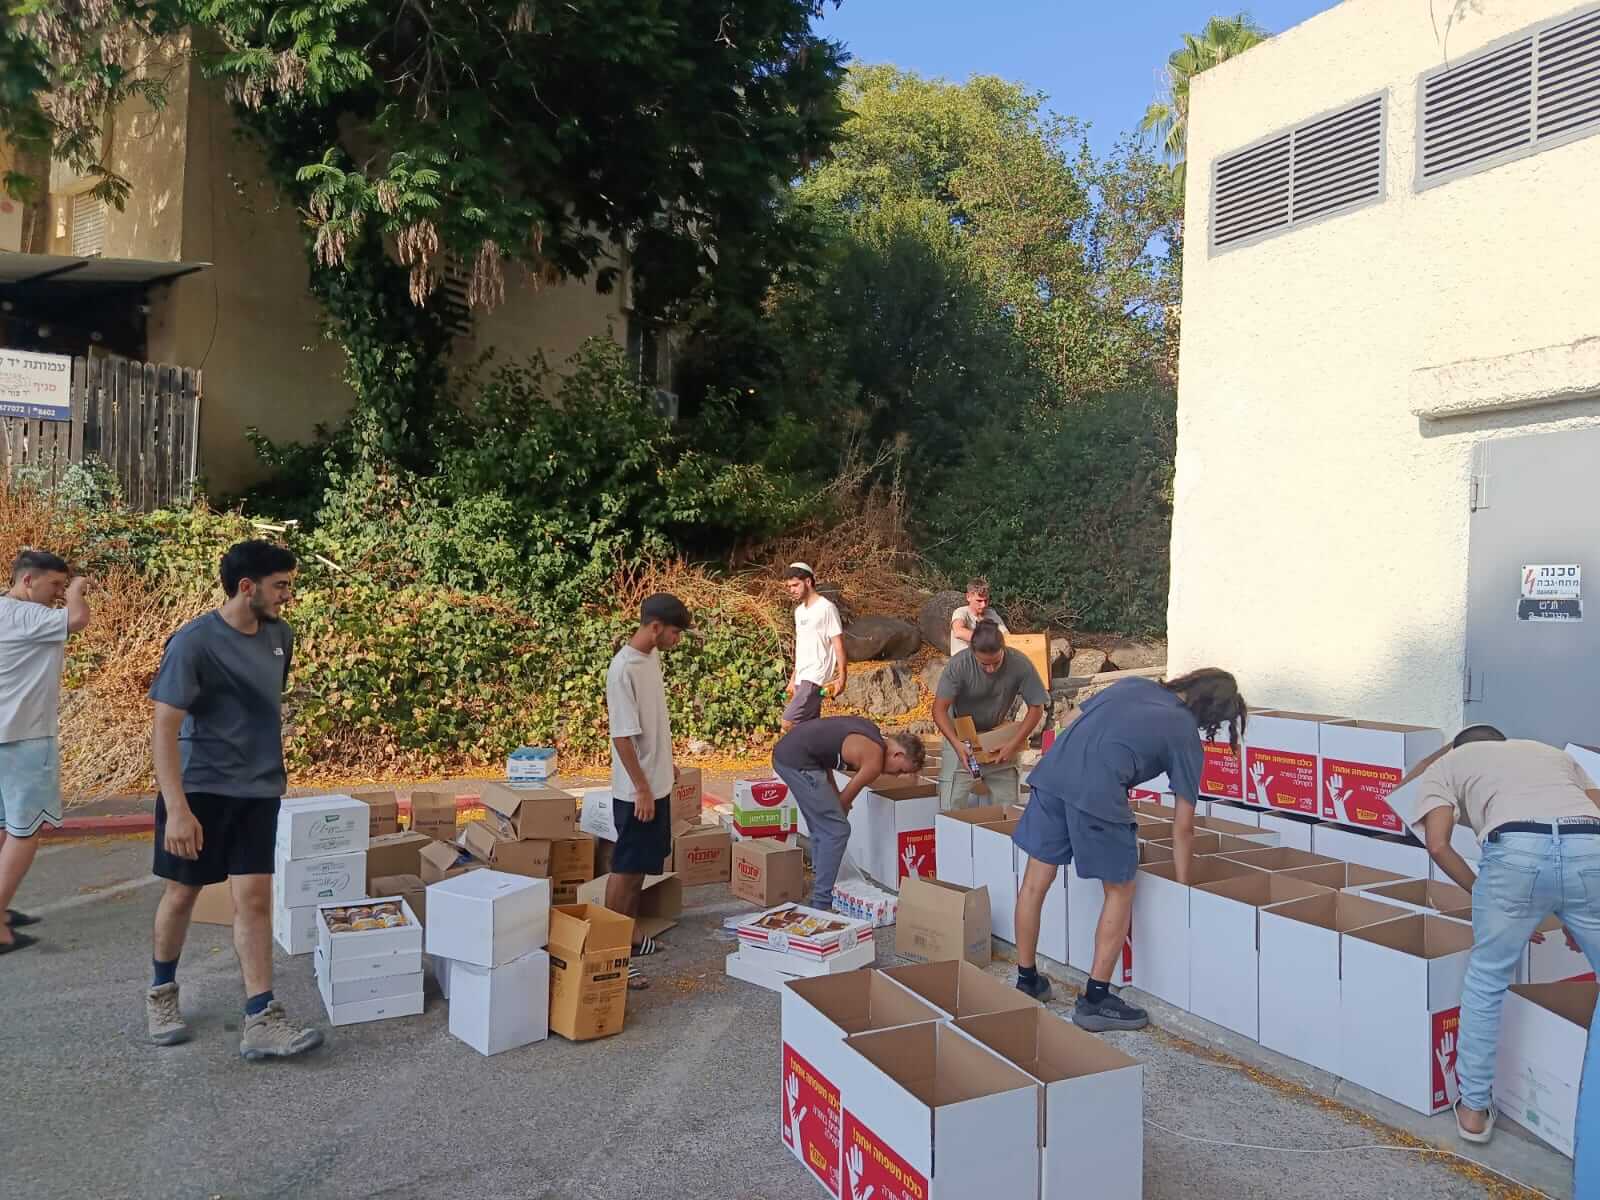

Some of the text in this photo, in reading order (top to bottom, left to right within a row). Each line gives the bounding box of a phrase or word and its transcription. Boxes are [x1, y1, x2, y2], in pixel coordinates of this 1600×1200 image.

[1541, 567, 1576, 577] סכנה
[852, 1127, 872, 1153] אחת!
[873, 1146, 902, 1181] משפחה
[903, 1173, 923, 1200] כולנו
